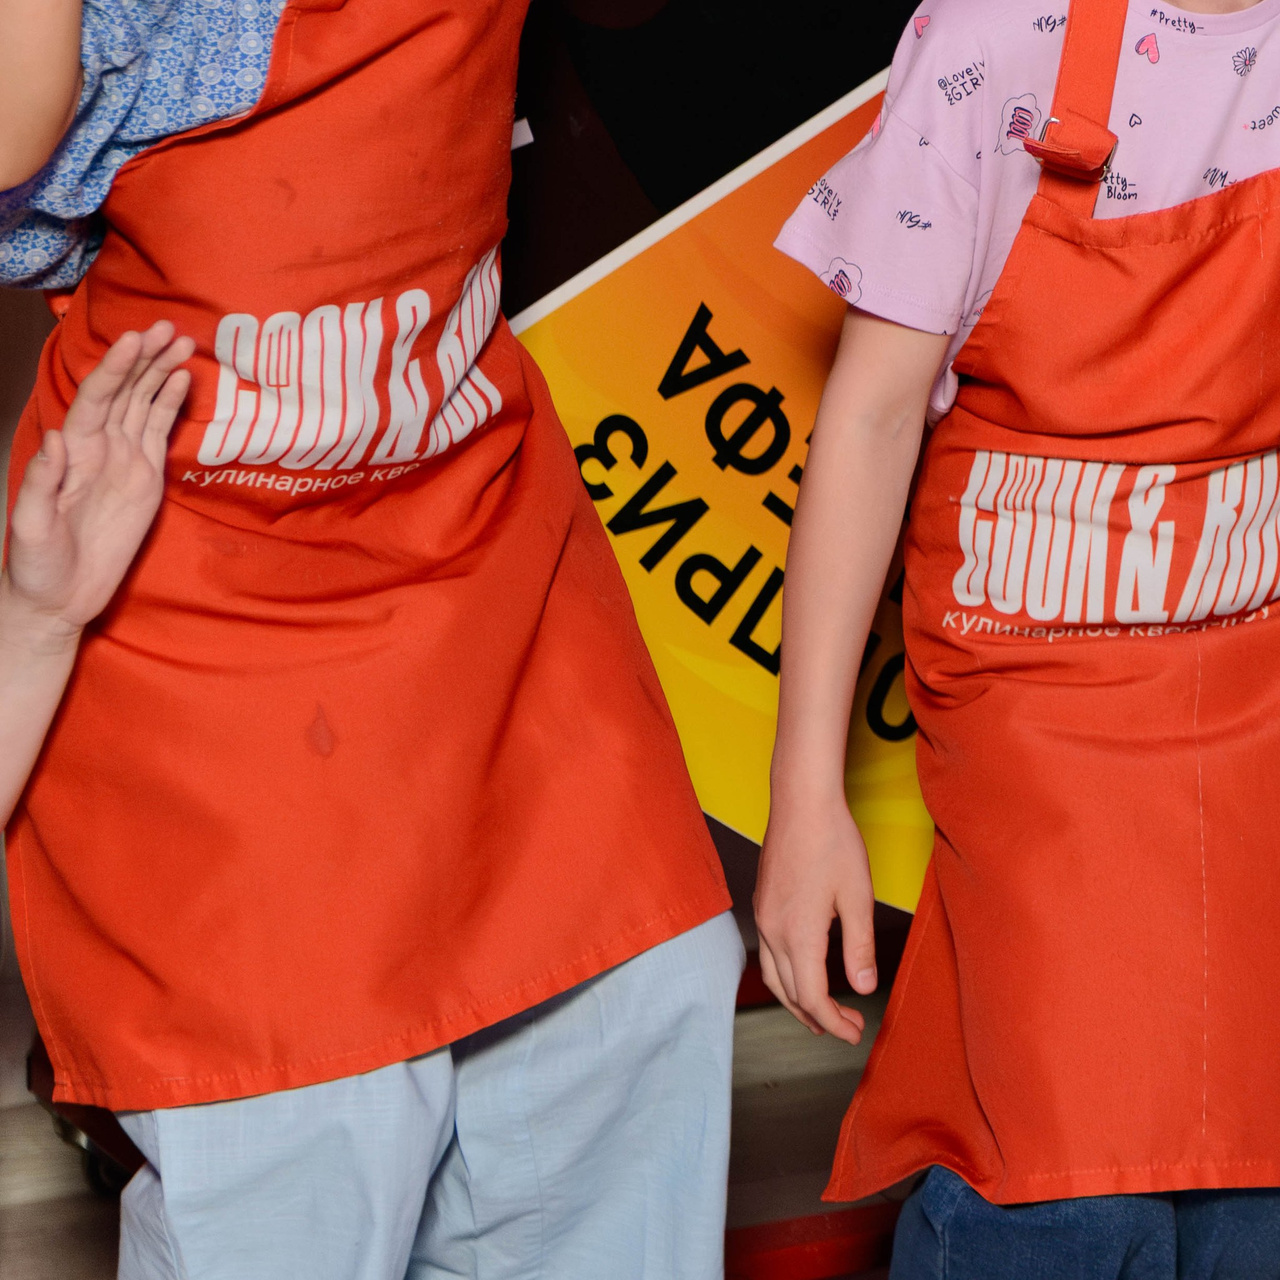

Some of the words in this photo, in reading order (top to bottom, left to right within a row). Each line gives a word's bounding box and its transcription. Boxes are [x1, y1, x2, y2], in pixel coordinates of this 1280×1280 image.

[1106, 185, 1138, 201] Bloom
[197, 297, 384, 470] COOK
[368, 288, 431, 466] &
[181, 469, 365, 497] кулинарное
[952, 450, 1127, 624] COOK
[1114, 464, 1177, 624] &
